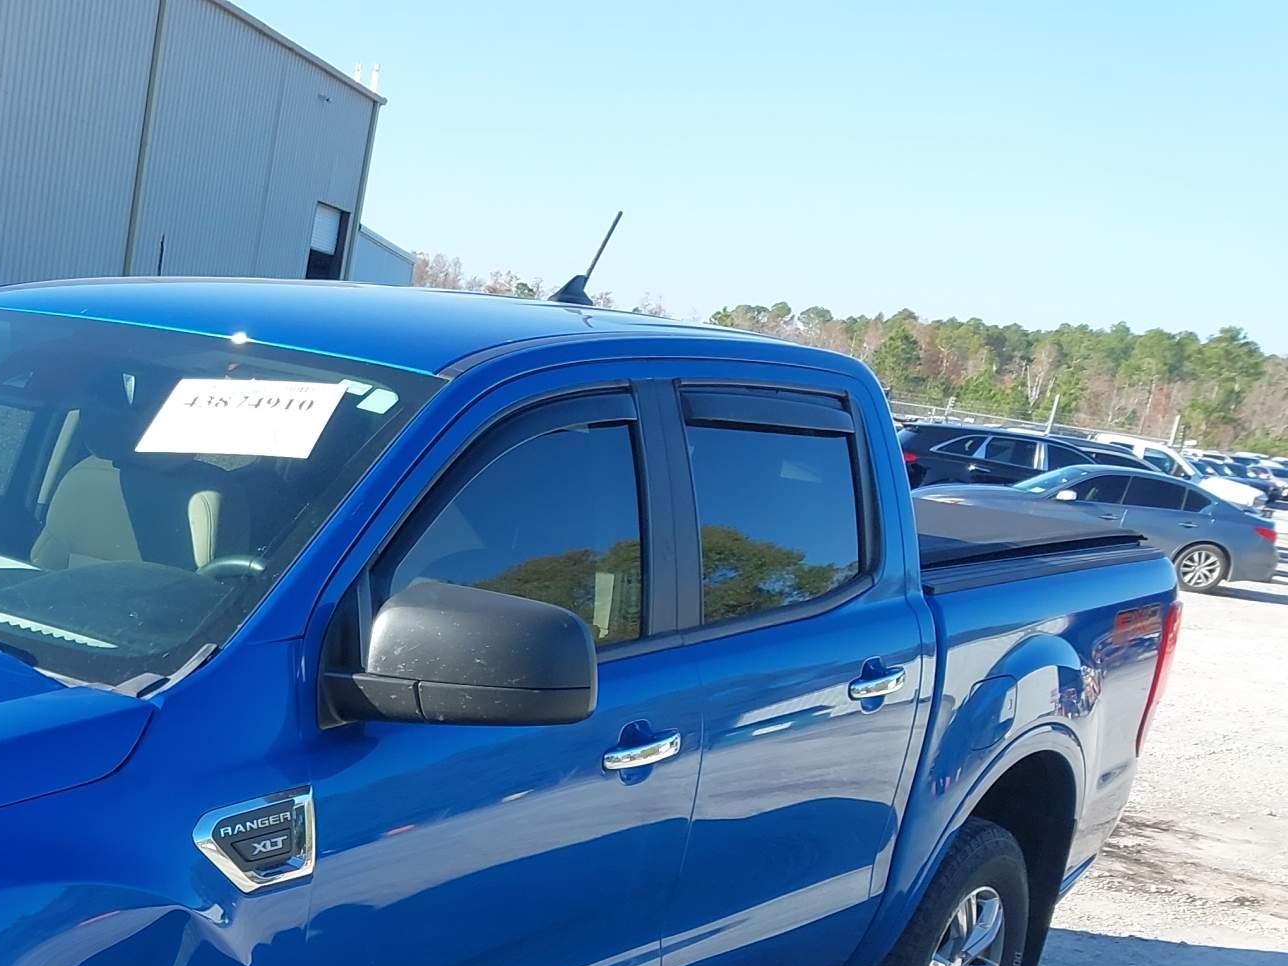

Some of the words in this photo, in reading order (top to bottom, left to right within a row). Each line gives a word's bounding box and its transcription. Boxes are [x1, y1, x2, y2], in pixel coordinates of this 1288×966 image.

[184, 395, 315, 411] 43874910
[220, 811, 291, 838] RANGER
[252, 835, 288, 855] XLT
